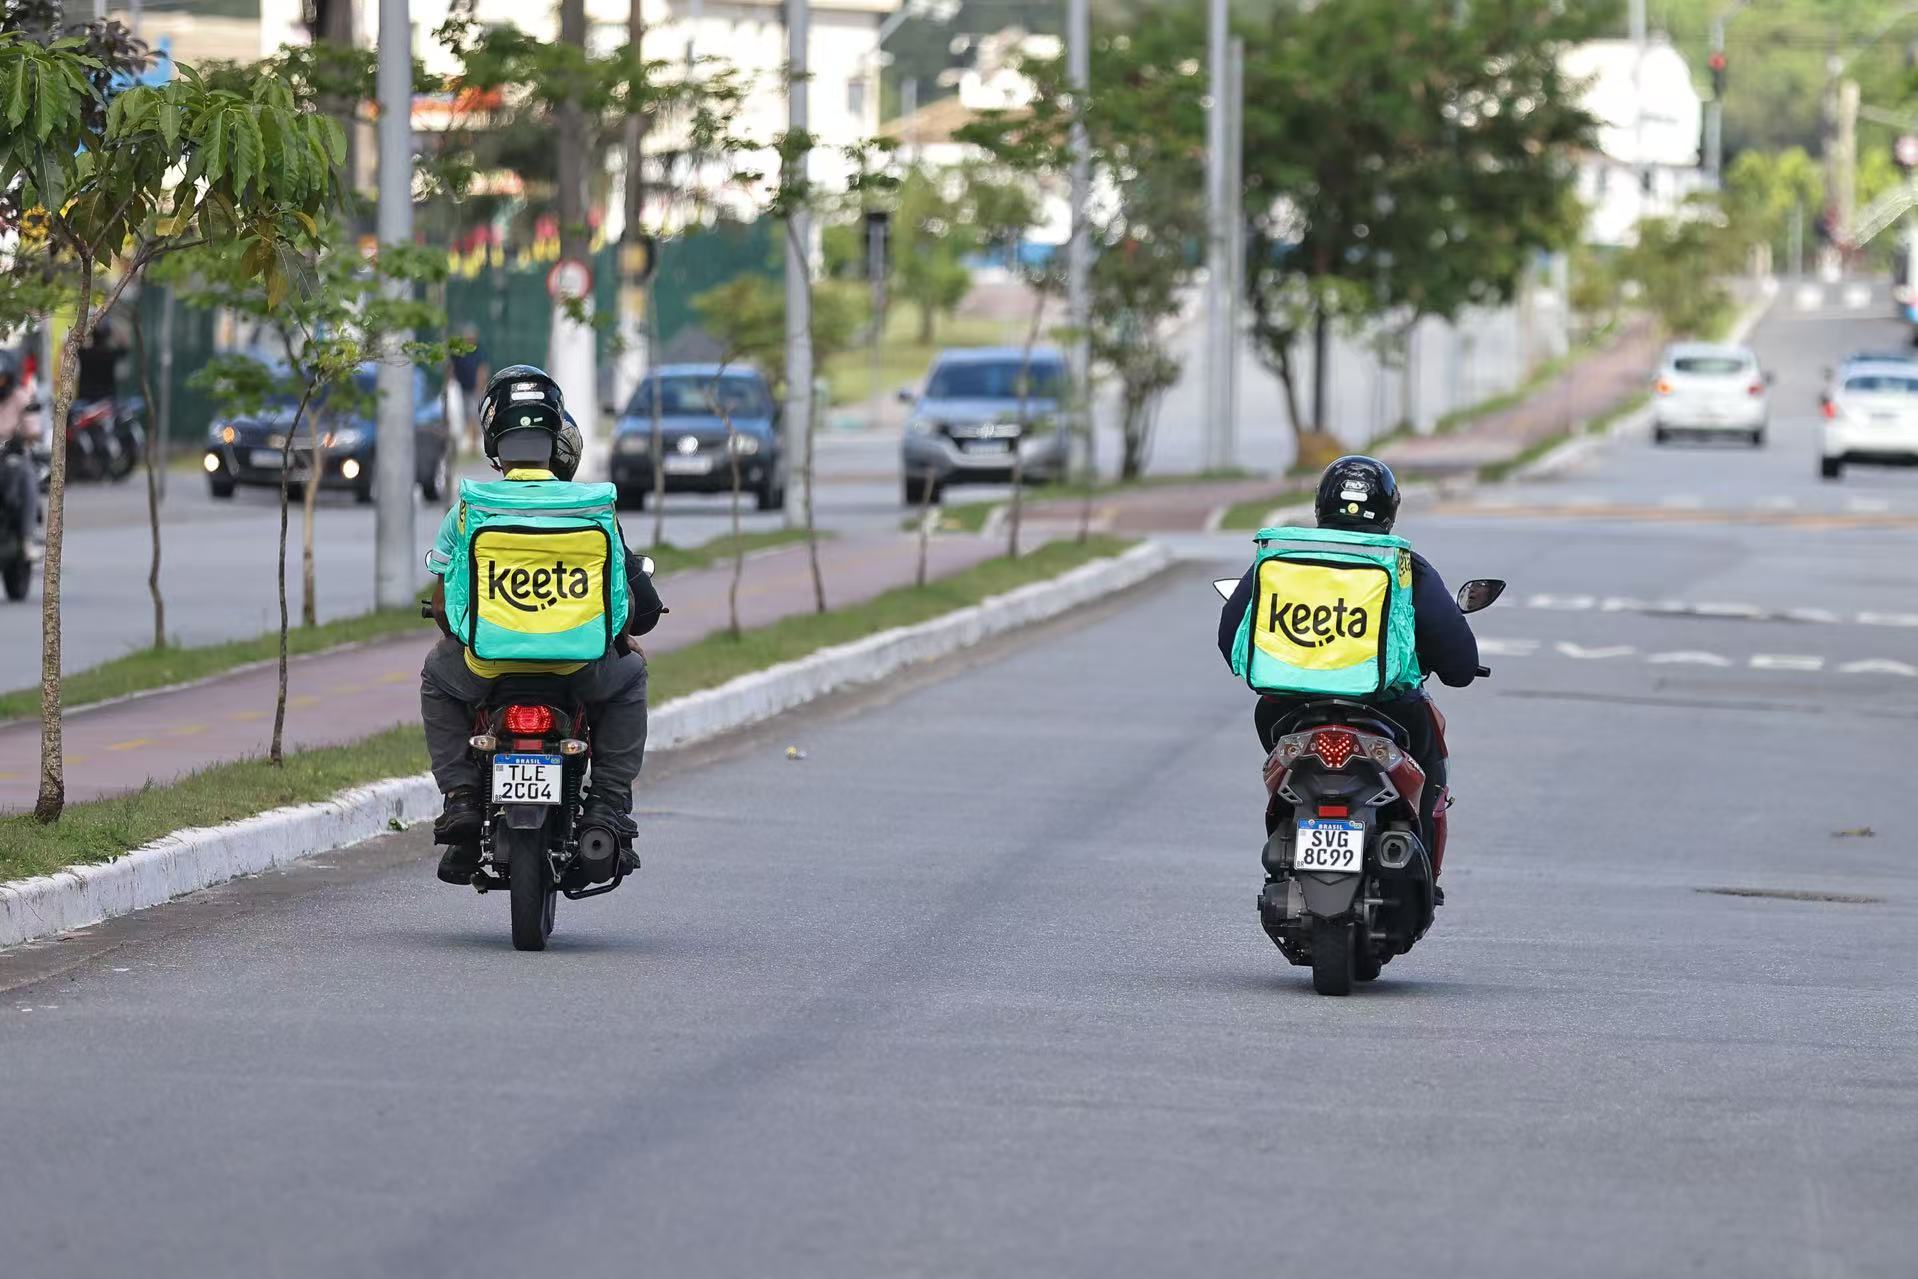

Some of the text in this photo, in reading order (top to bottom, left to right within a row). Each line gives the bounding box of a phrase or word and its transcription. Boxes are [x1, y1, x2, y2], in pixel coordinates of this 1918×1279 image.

[489, 560, 589, 612] keeta
[1269, 593, 1368, 648] keeta
[508, 765, 546, 782] TLE
[501, 782, 552, 800] 2C04
[1311, 830, 1349, 848] SVG
[1303, 848, 1354, 867] 8C99
